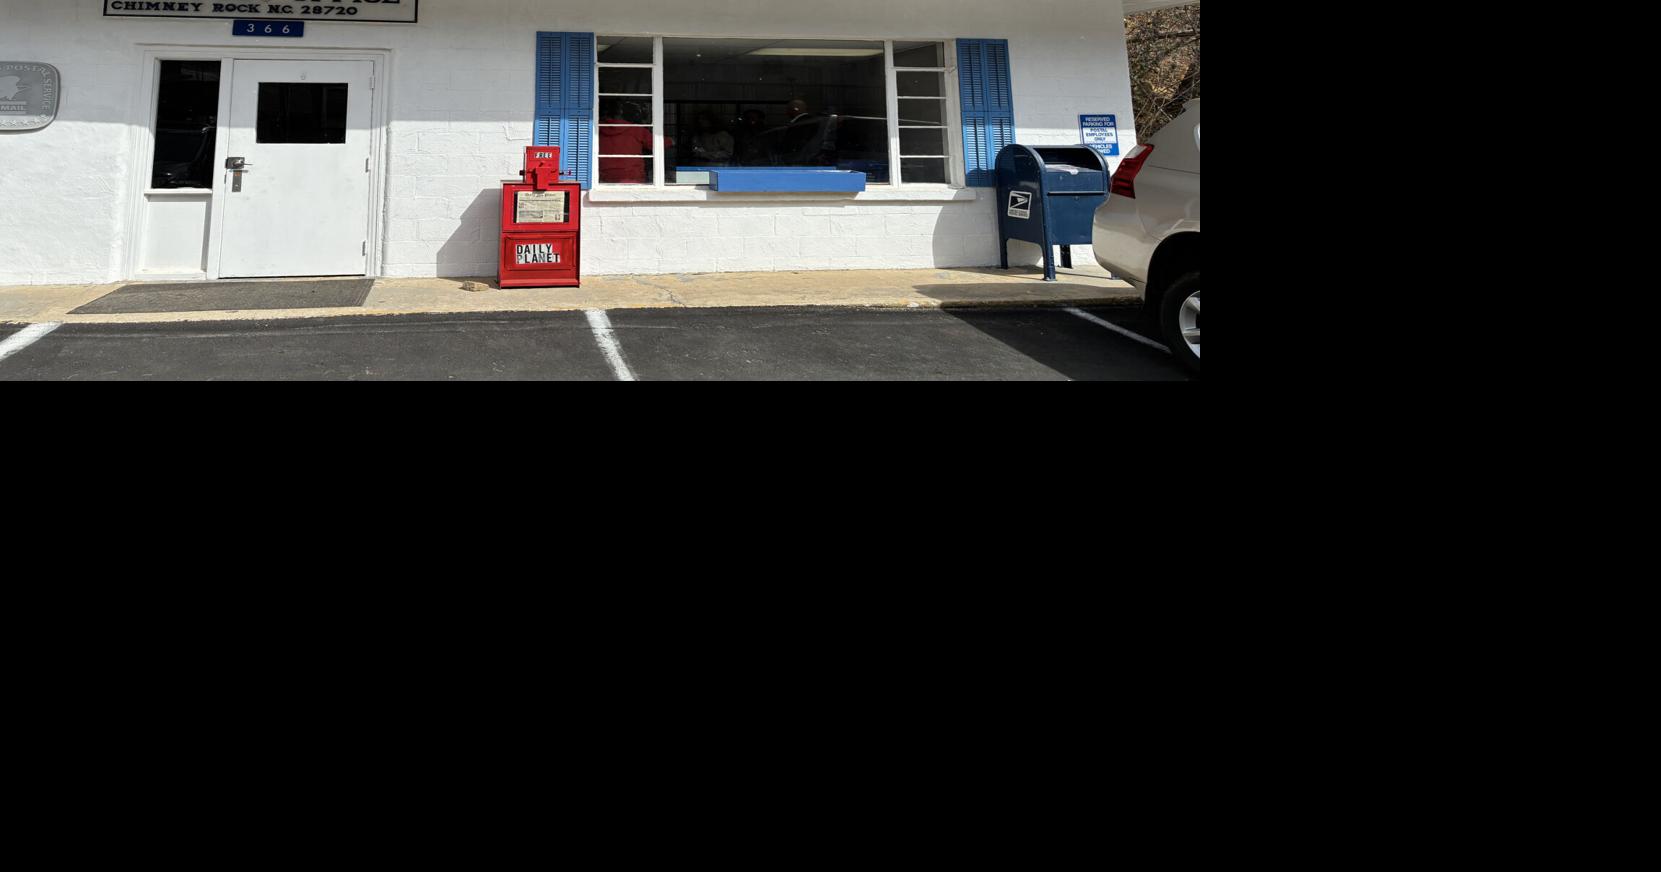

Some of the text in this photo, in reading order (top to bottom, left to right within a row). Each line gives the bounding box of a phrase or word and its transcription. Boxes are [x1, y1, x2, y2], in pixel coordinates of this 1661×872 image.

[111, 1, 202, 12] CHIMNEY
[212, 3, 261, 13] ROCK
[301, 5, 358, 15] 28720
[516, 244, 552, 254] DAILY
[516, 253, 560, 264] PLANET
